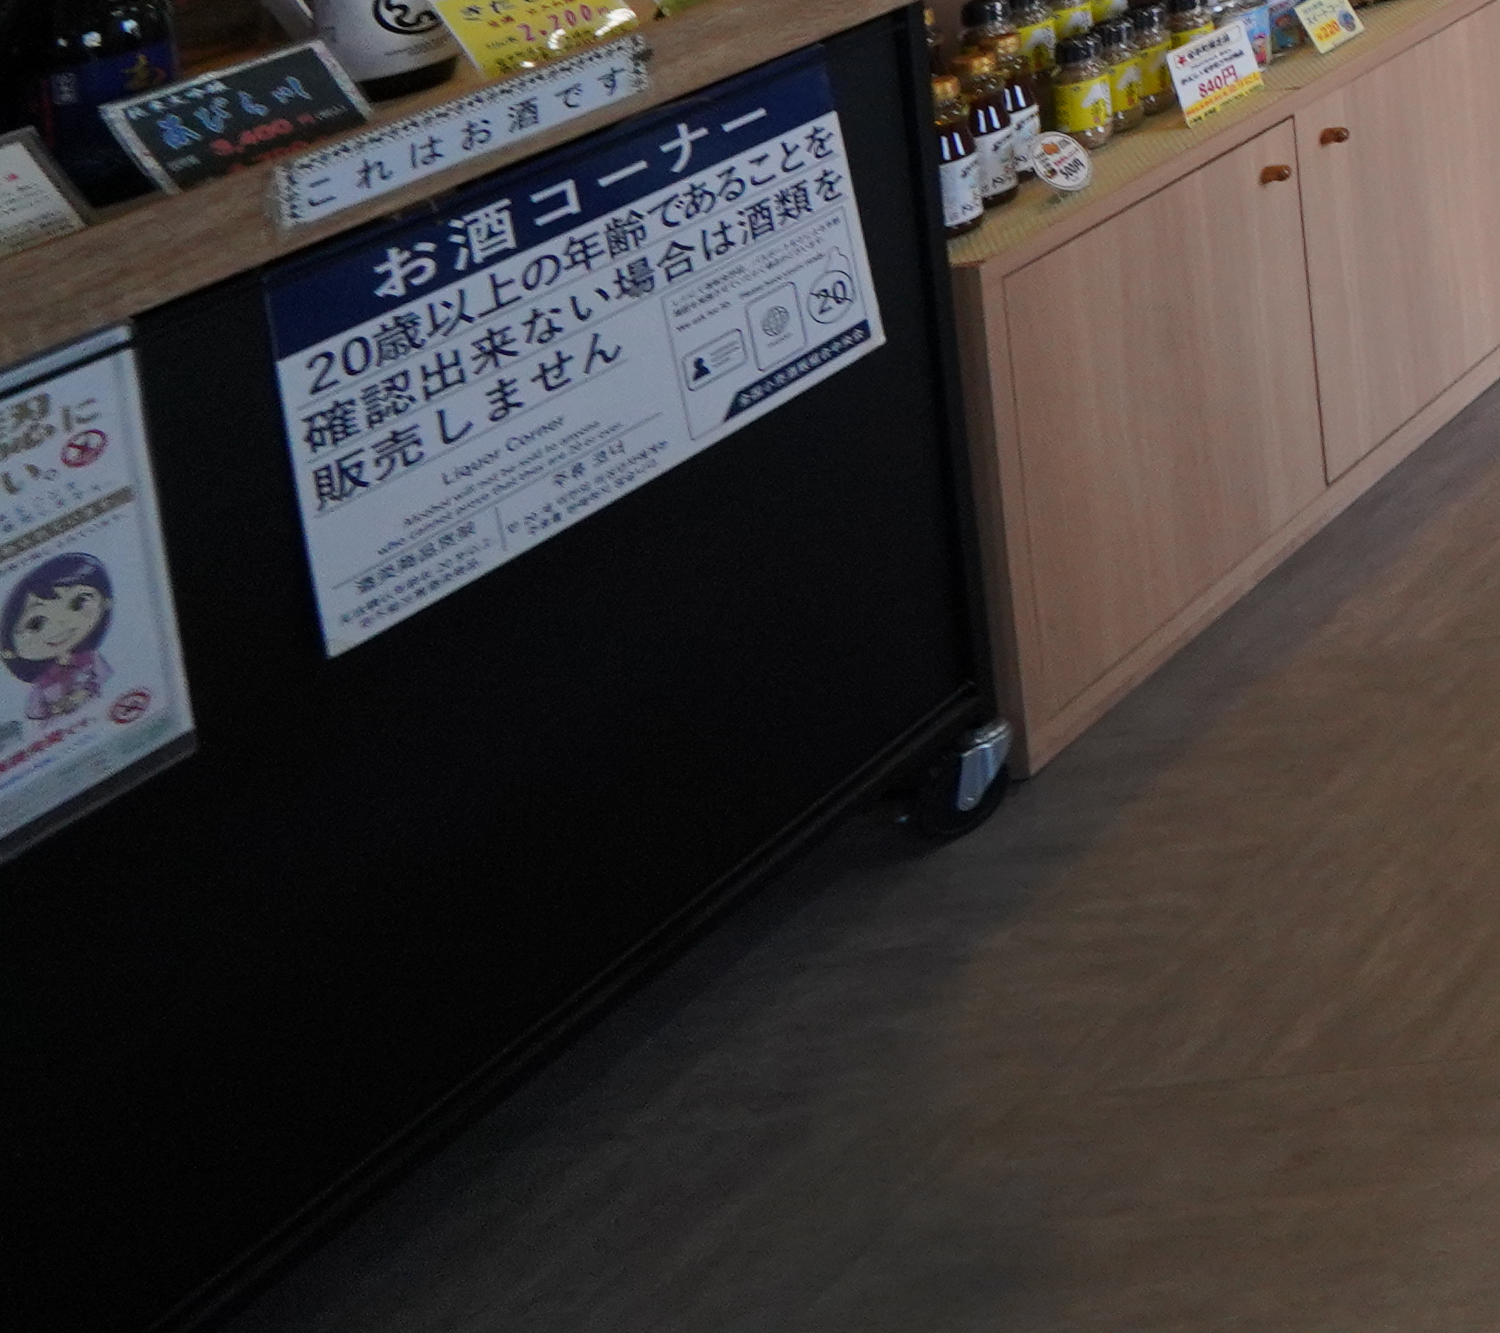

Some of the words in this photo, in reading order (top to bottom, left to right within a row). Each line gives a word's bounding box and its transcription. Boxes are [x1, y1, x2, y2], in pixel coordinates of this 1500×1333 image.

[308, 66, 626, 209] これはお酒です
[373, 106, 768, 300] お酒コーナー
[302, 168, 844, 454] 確認出来ない場合は酒類を
[305, 125, 834, 395] 20歳以上の年齢であることを
[313, 333, 622, 511] 販売しません
